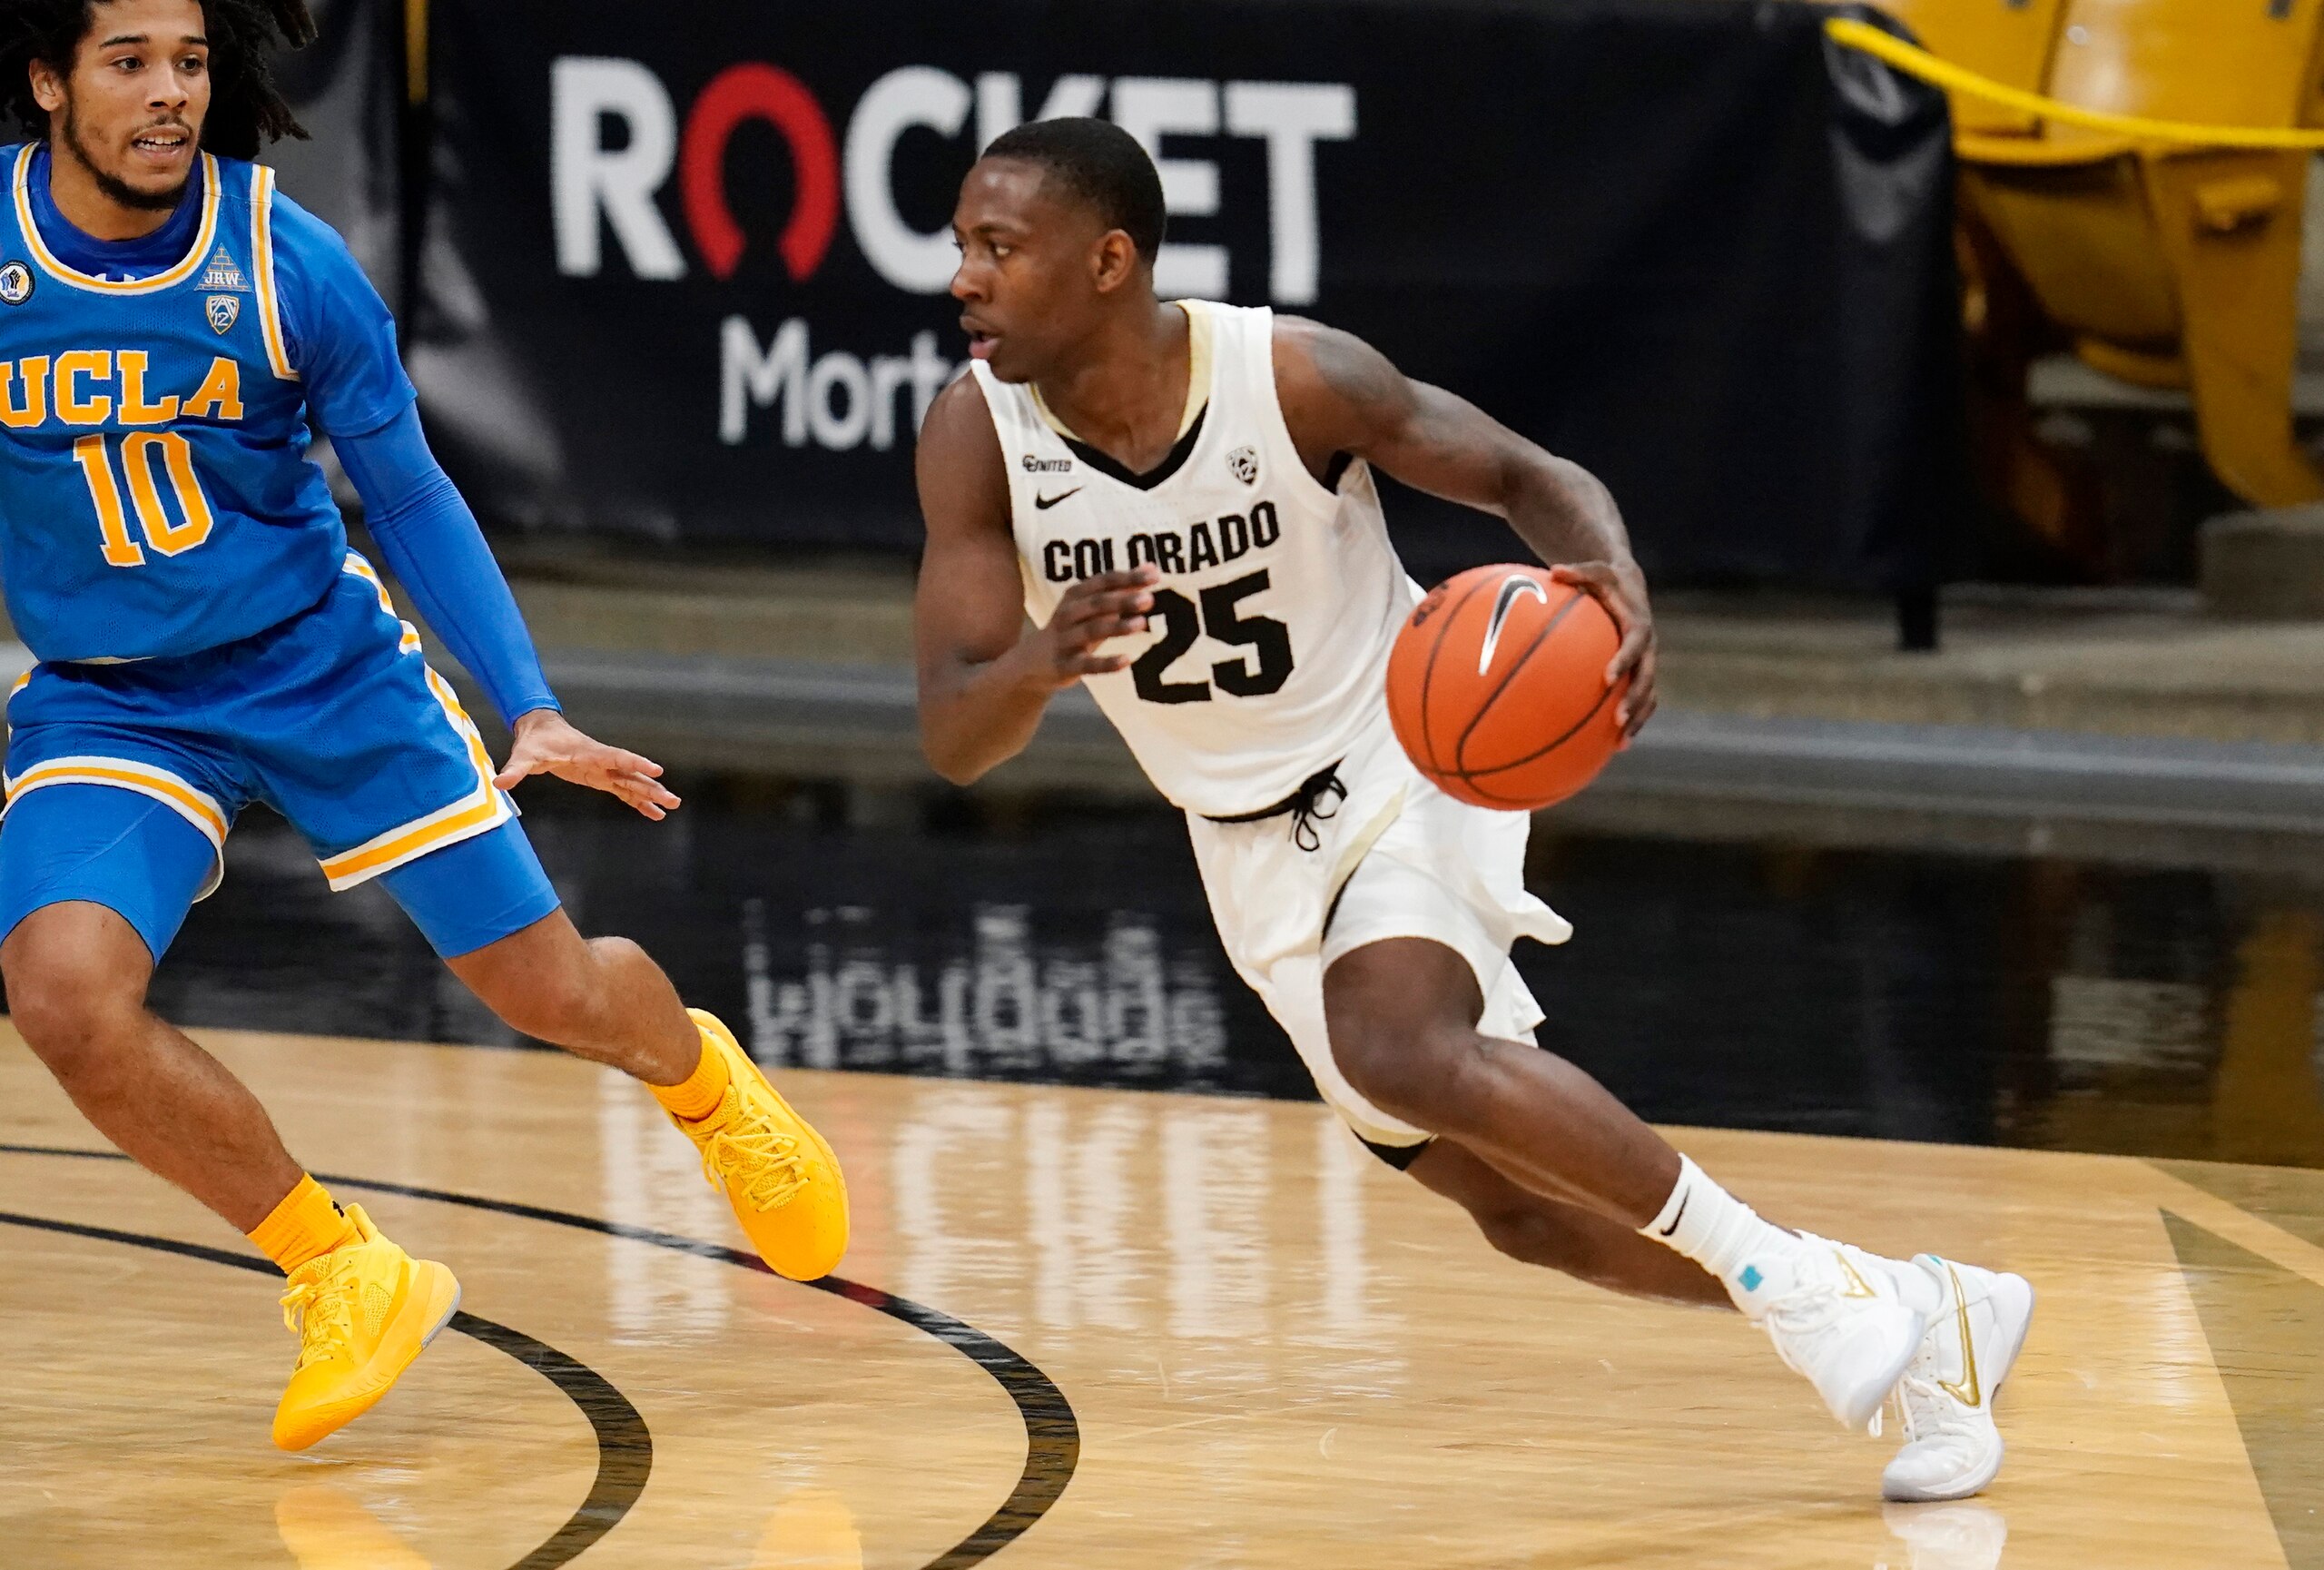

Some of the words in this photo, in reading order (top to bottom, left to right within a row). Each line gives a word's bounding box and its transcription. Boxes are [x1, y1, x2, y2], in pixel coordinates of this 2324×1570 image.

[549, 55, 1357, 306] ROCET
[204, 272, 240, 284] JRW
[214, 311, 229, 326] 12
[0, 349, 243, 428] UCLA
[718, 313, 968, 451] Mort
[73, 430, 213, 567] 10
[1044, 500, 1280, 582] COLORADO
[1130, 568, 1295, 704] 25
